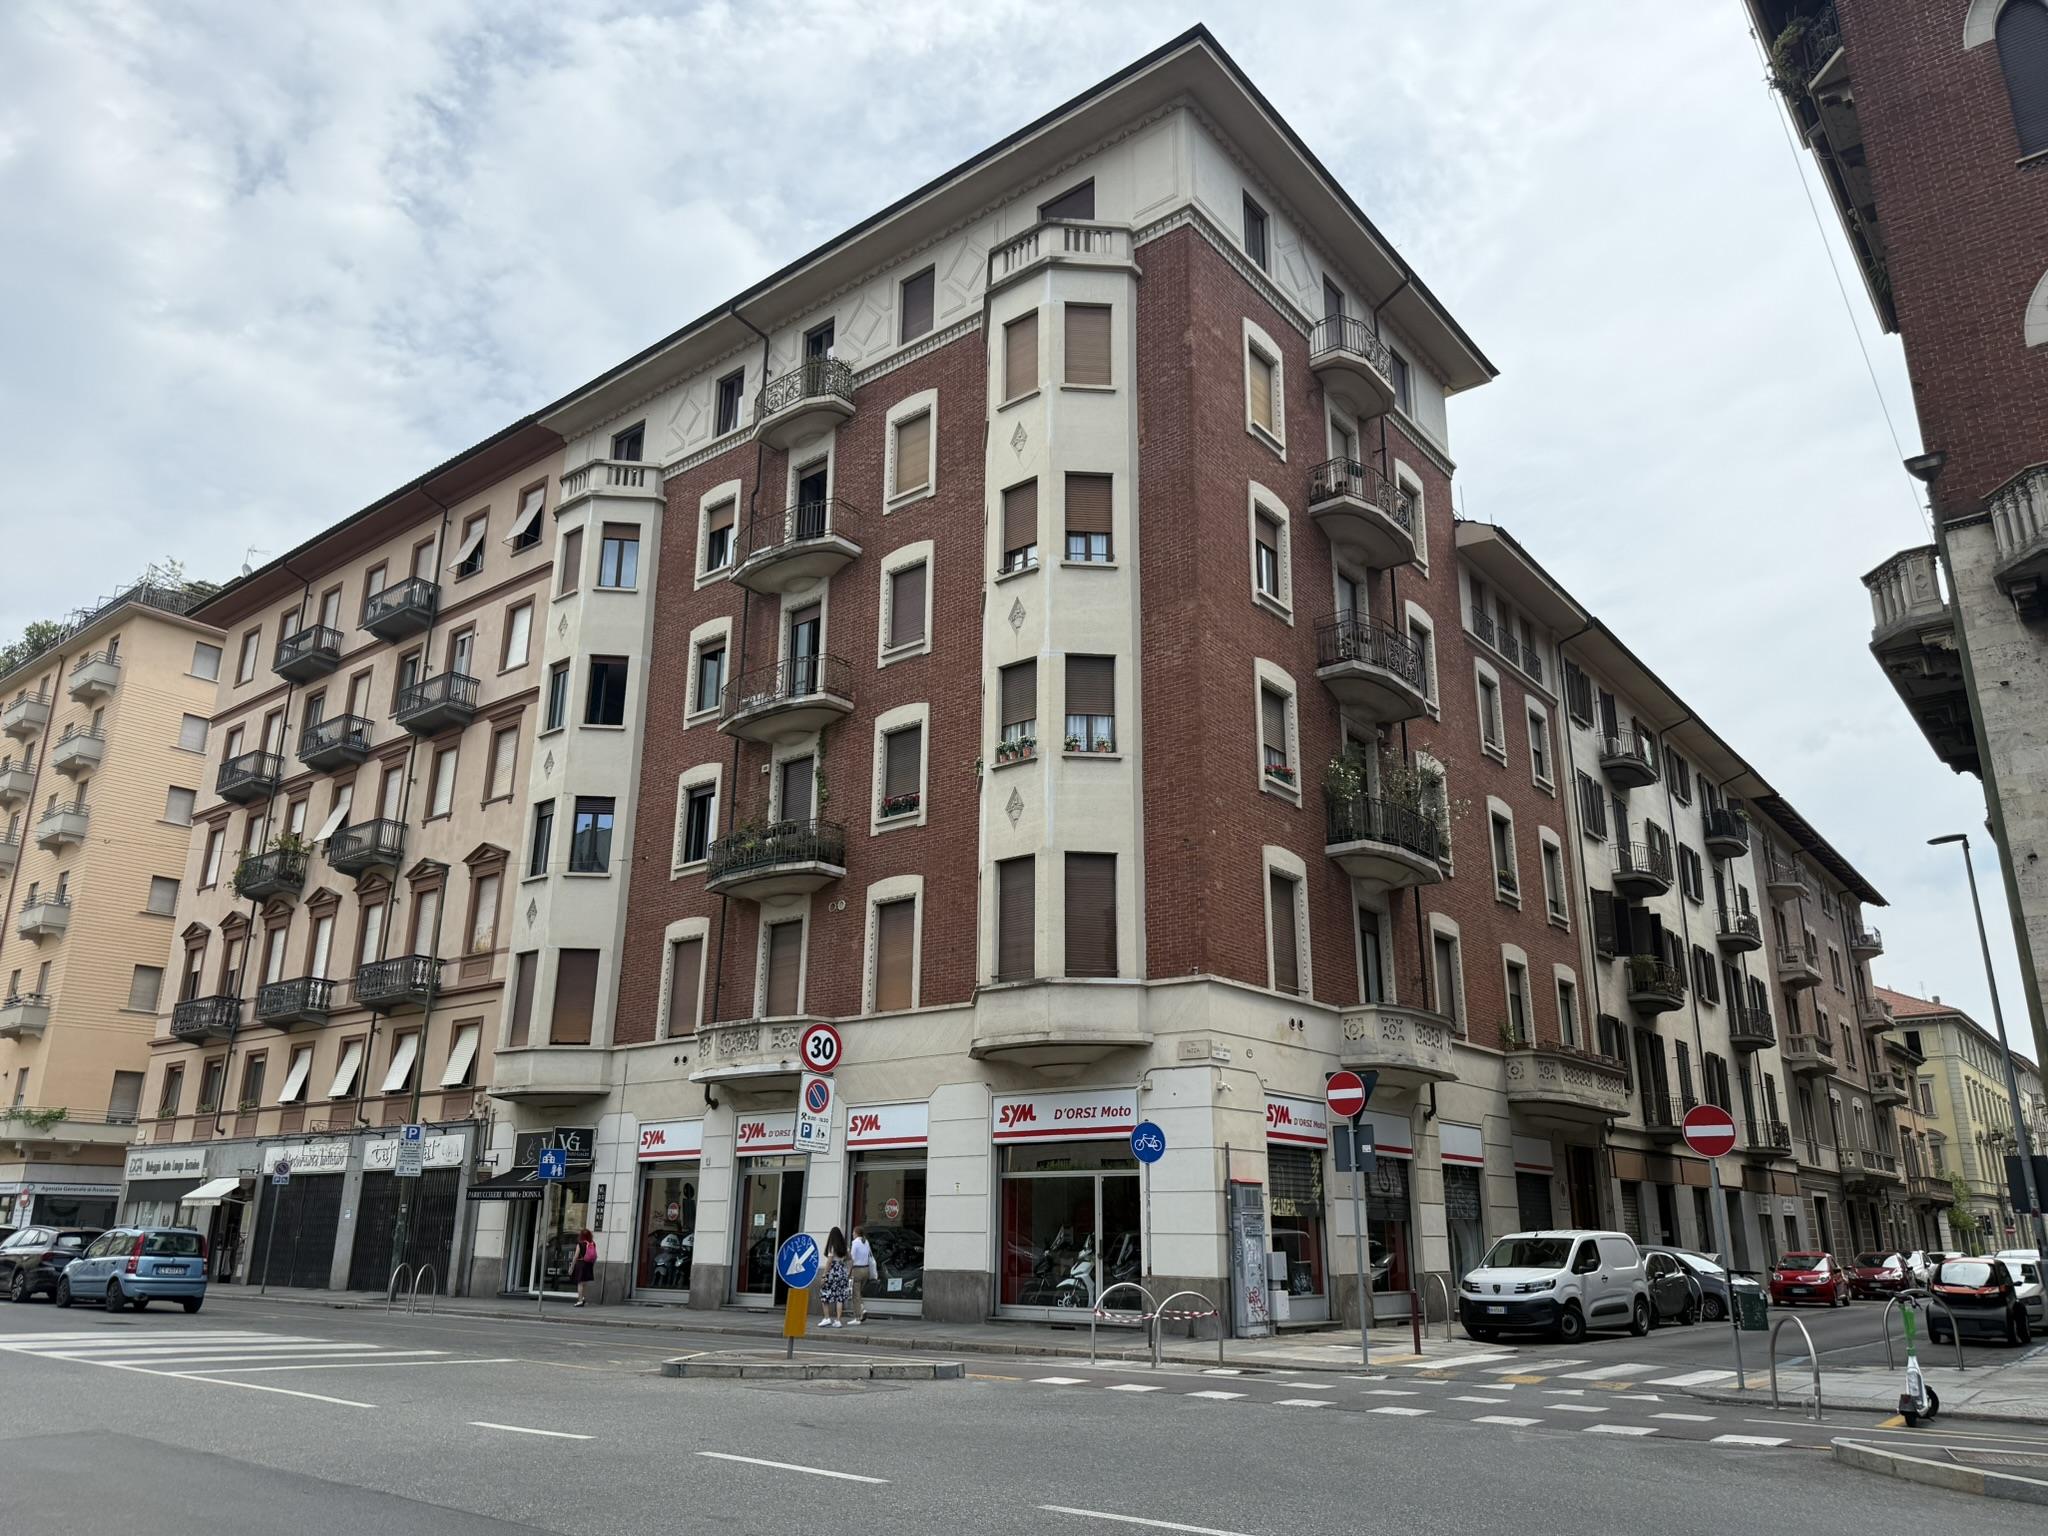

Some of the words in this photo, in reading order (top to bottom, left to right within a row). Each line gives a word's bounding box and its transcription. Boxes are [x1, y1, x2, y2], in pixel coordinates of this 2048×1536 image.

[811, 1036, 834, 1060] 30
[849, 1114, 881, 1137] SYM
[999, 1104, 1036, 1128] SYM
[1054, 1107, 1097, 1121] D'ORSI
[1101, 1106, 1131, 1118] Moto
[1266, 1104, 1292, 1128] SYM
[408, 1128, 417, 1139] P
[641, 1130, 666, 1149] SYM
[738, 1122, 767, 1143] SYM
[803, 1125, 810, 1137] P
